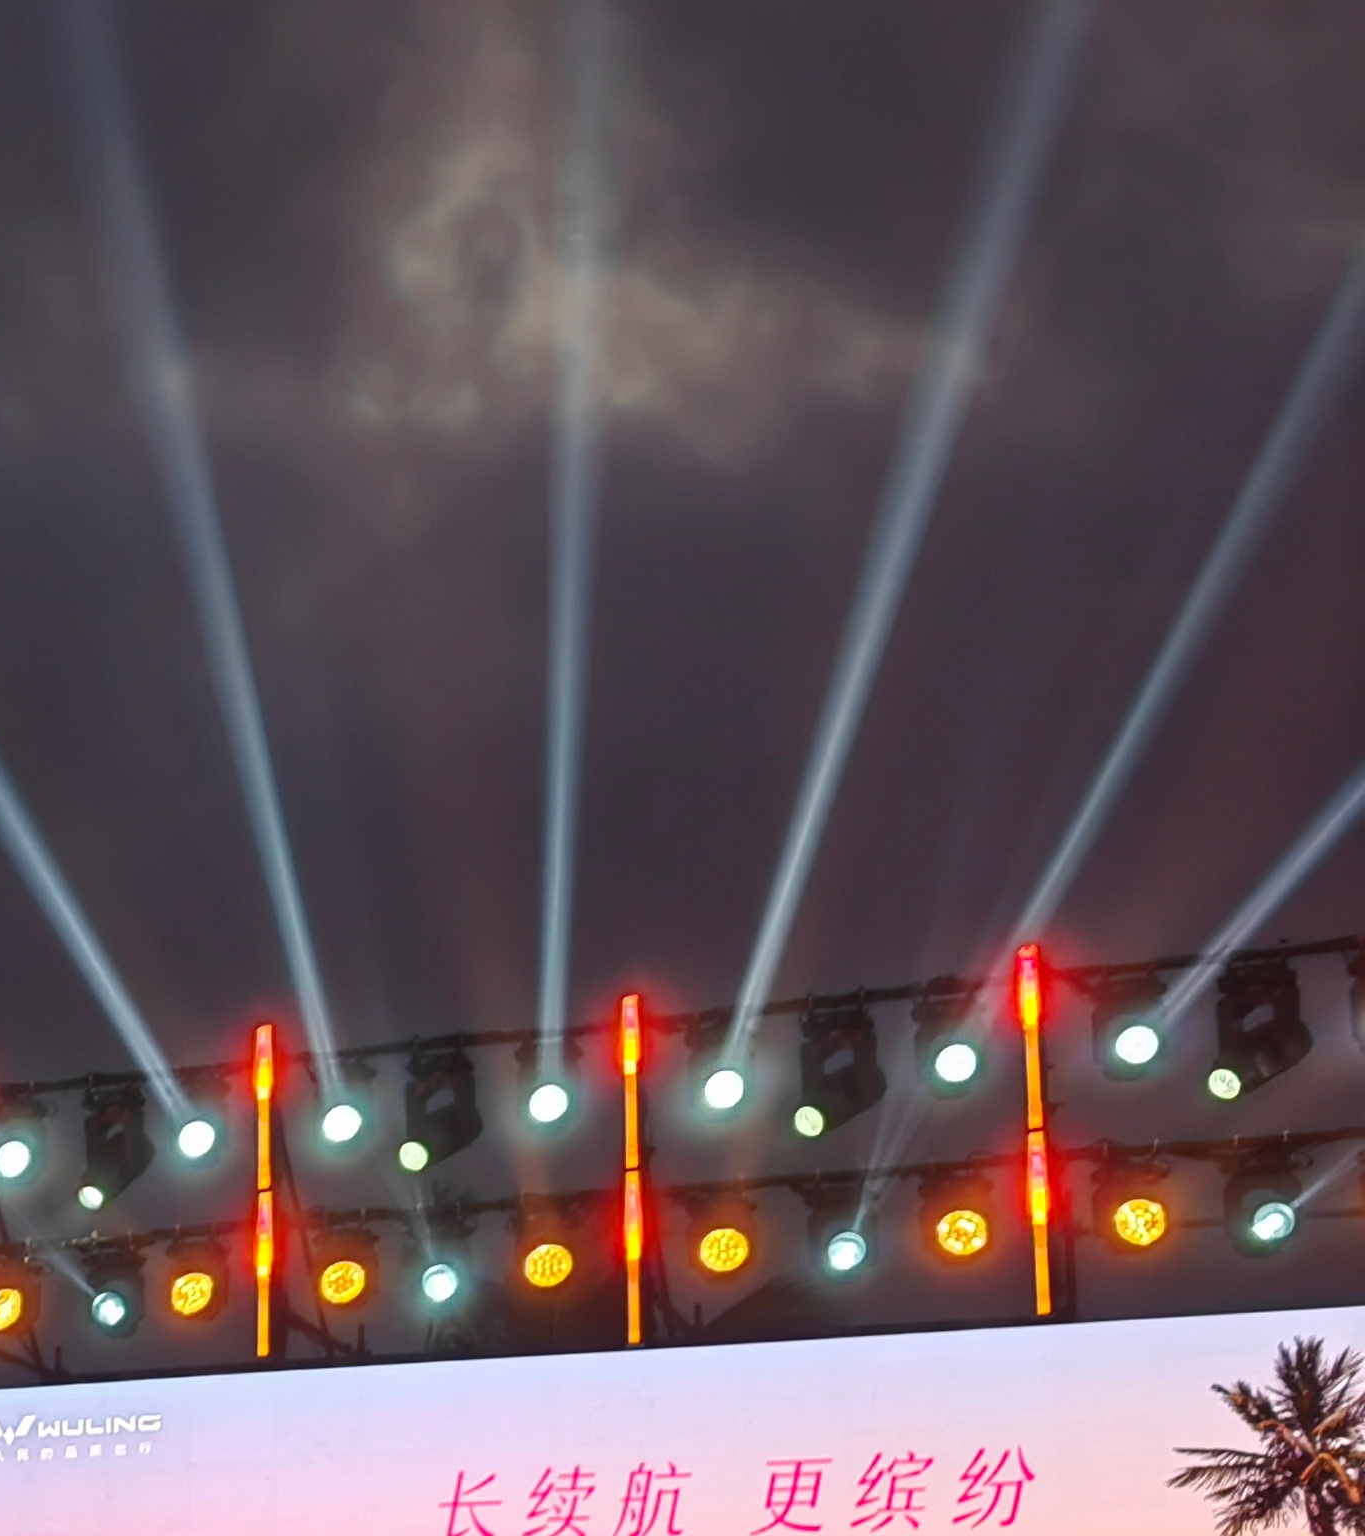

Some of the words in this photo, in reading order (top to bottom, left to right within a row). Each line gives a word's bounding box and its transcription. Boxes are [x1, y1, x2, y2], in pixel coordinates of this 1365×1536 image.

[38, 1414, 162, 1438] WULING
[749, 1445, 1036, 1536] 更缤纷
